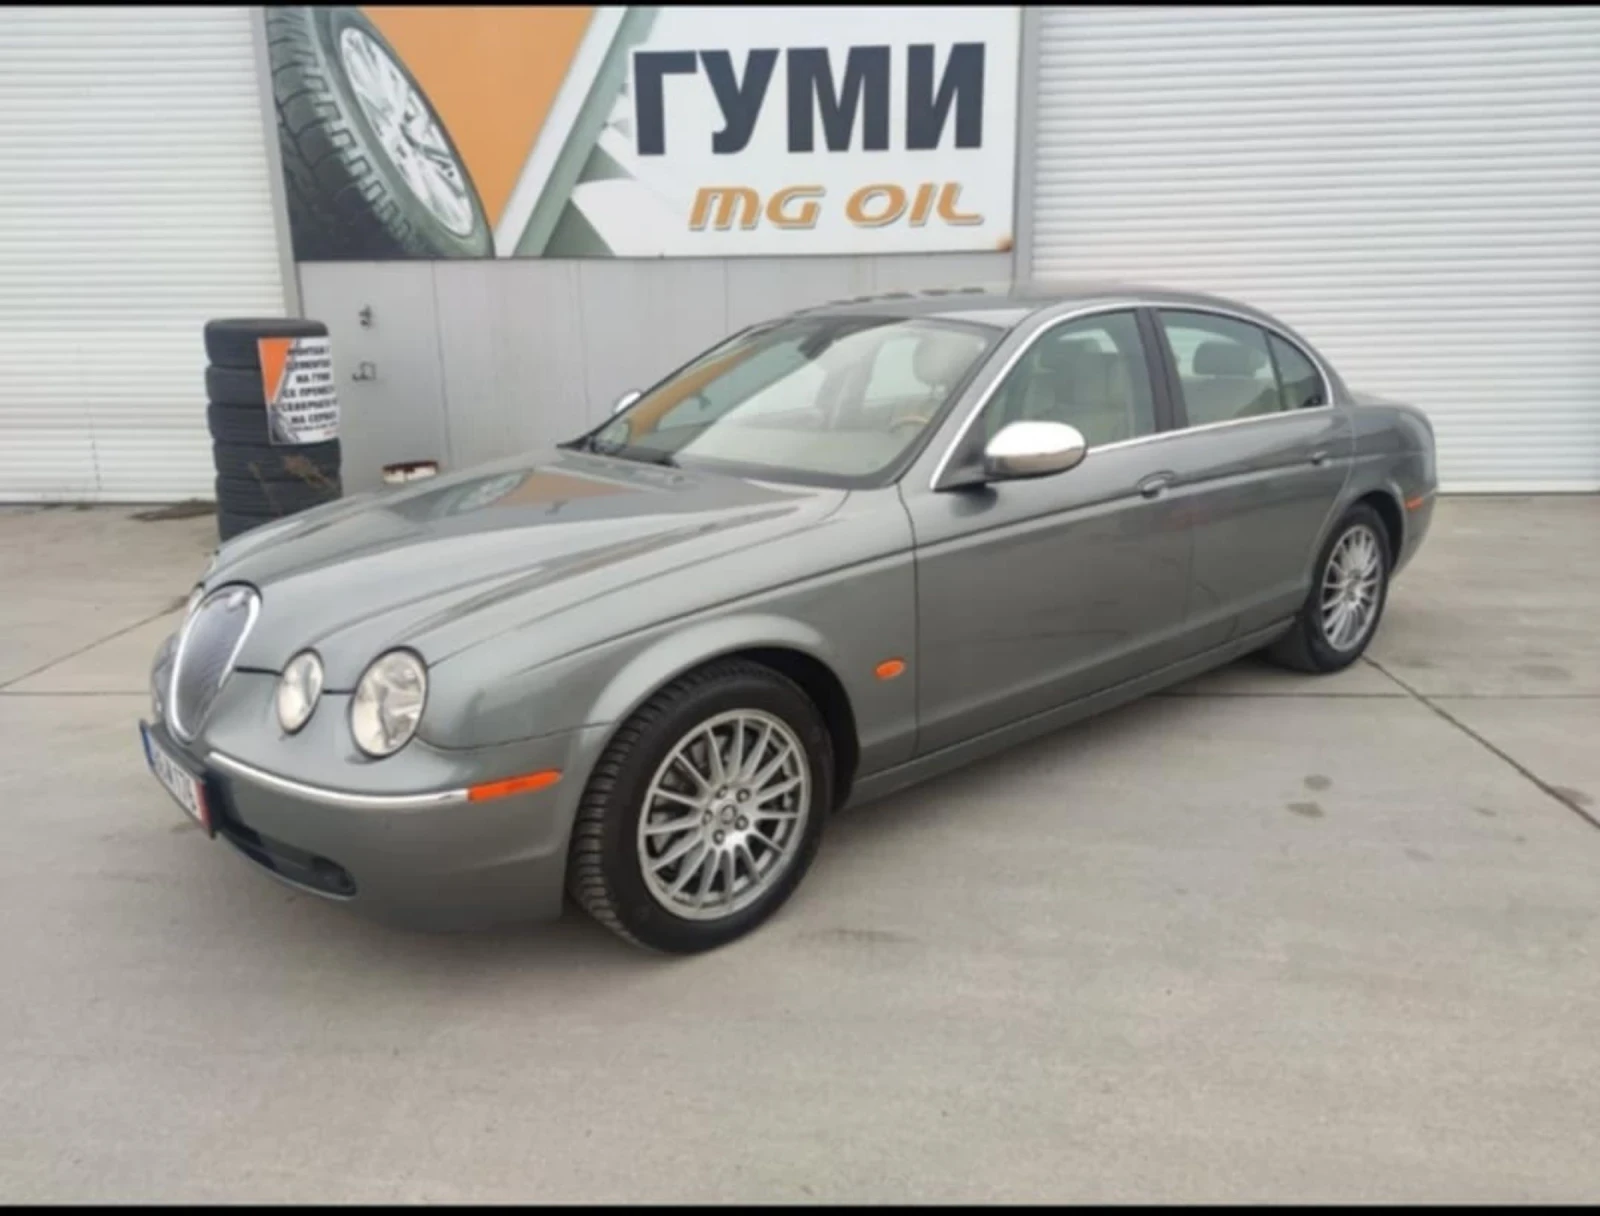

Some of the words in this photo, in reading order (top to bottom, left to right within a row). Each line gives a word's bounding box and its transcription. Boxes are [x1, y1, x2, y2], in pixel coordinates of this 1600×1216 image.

[634, 42, 985, 156] ГУМИ
[688, 185, 826, 231] MG
[845, 182, 985, 228] OIL
